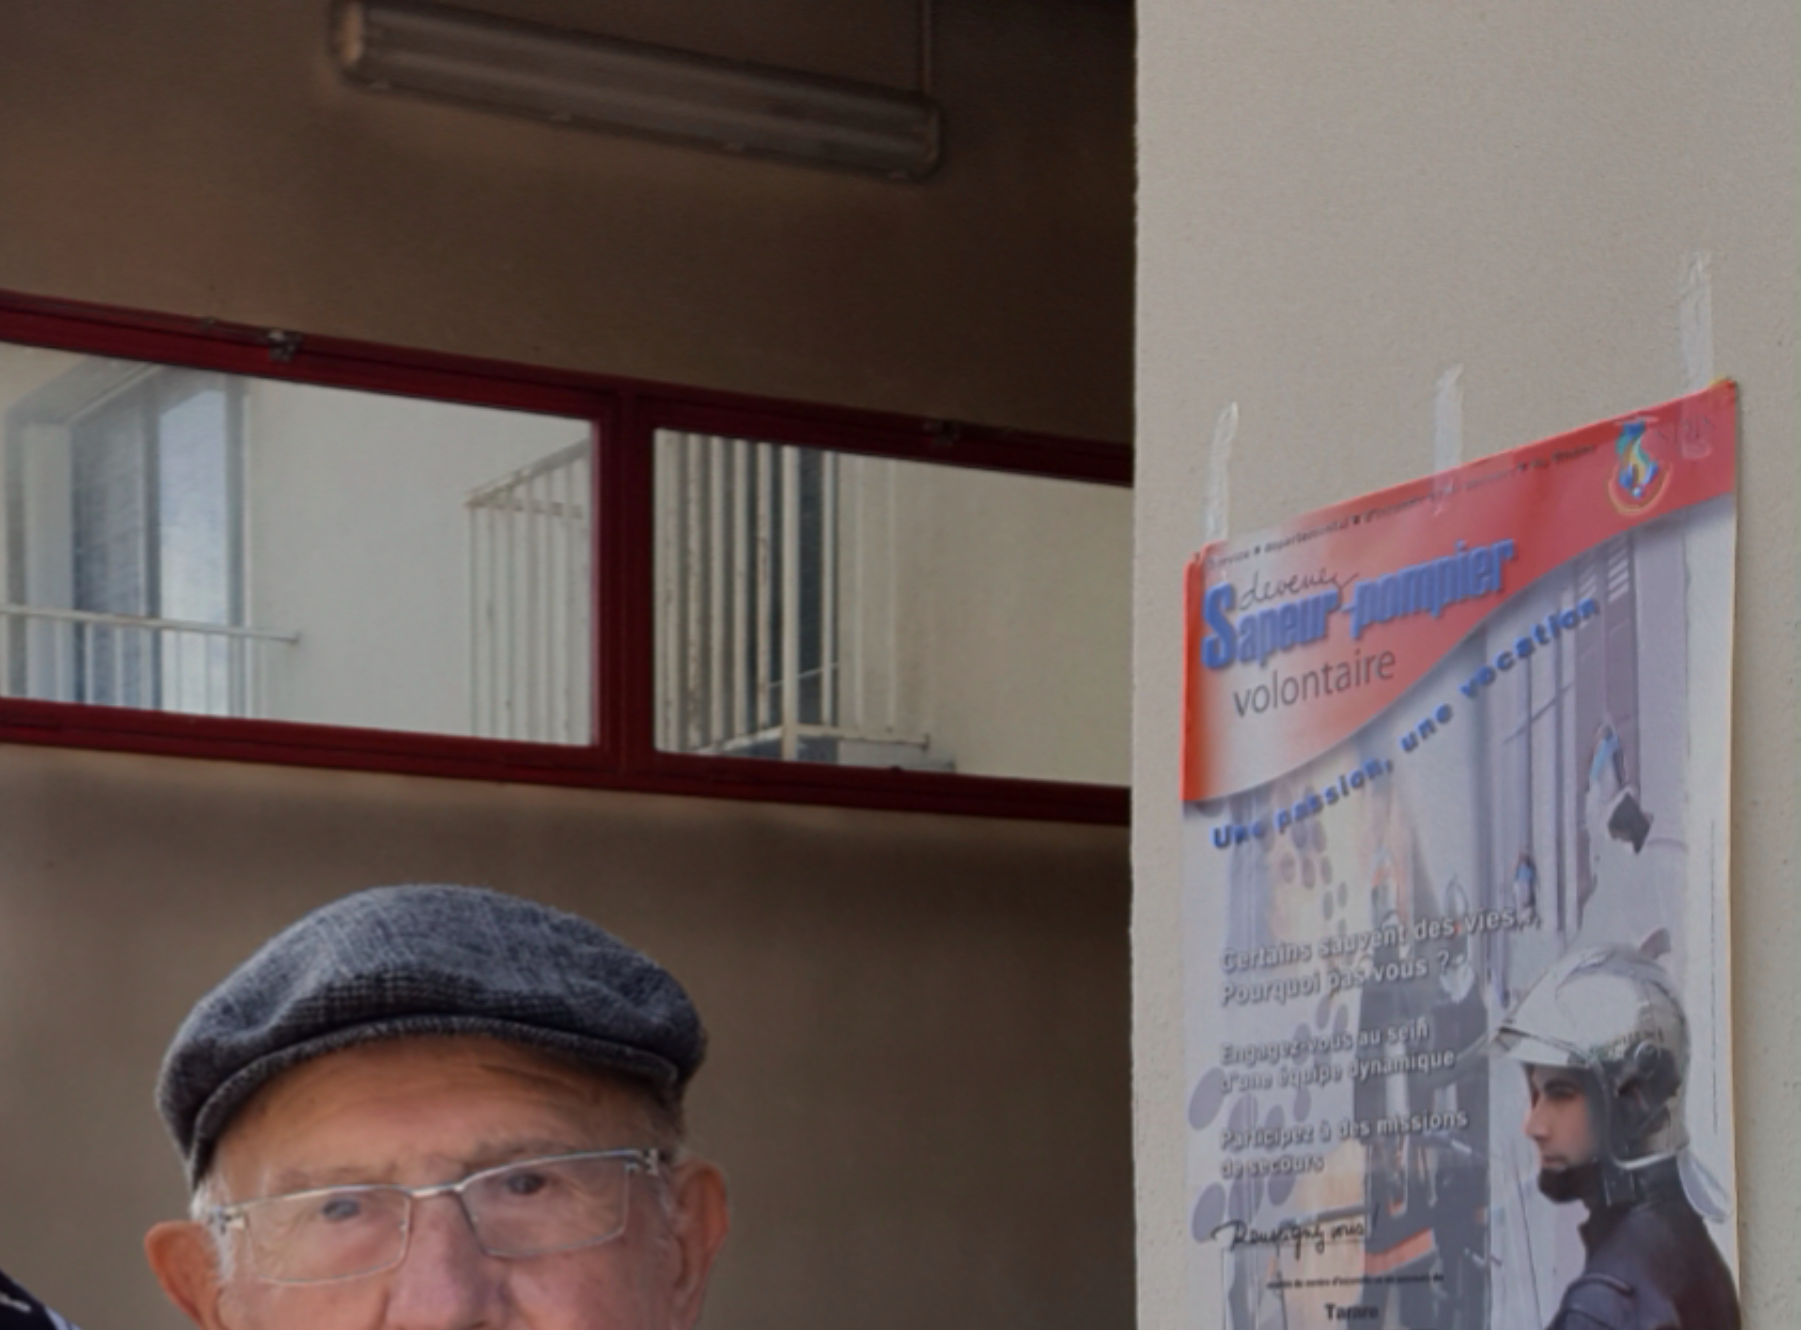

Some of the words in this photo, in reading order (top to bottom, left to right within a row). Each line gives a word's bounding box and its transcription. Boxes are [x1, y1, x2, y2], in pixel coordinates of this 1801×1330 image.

[1233, 648, 1396, 717] volontaire
[1399, 702, 1455, 753] une
[1459, 598, 1601, 698] vocation
[1221, 941, 1312, 976] Certains
[1318, 923, 1407, 960] sauvent
[1413, 917, 1456, 942] des
[1221, 972, 1321, 1008] Pourquoi
[1327, 964, 1368, 994] pas
[1372, 957, 1429, 983] vous
[1387, 1014, 1431, 1040] sein
[1348, 1049, 1457, 1083] dynamique
[1375, 1106, 1468, 1137] missions
[1324, 1302, 1380, 1321] Tarare
